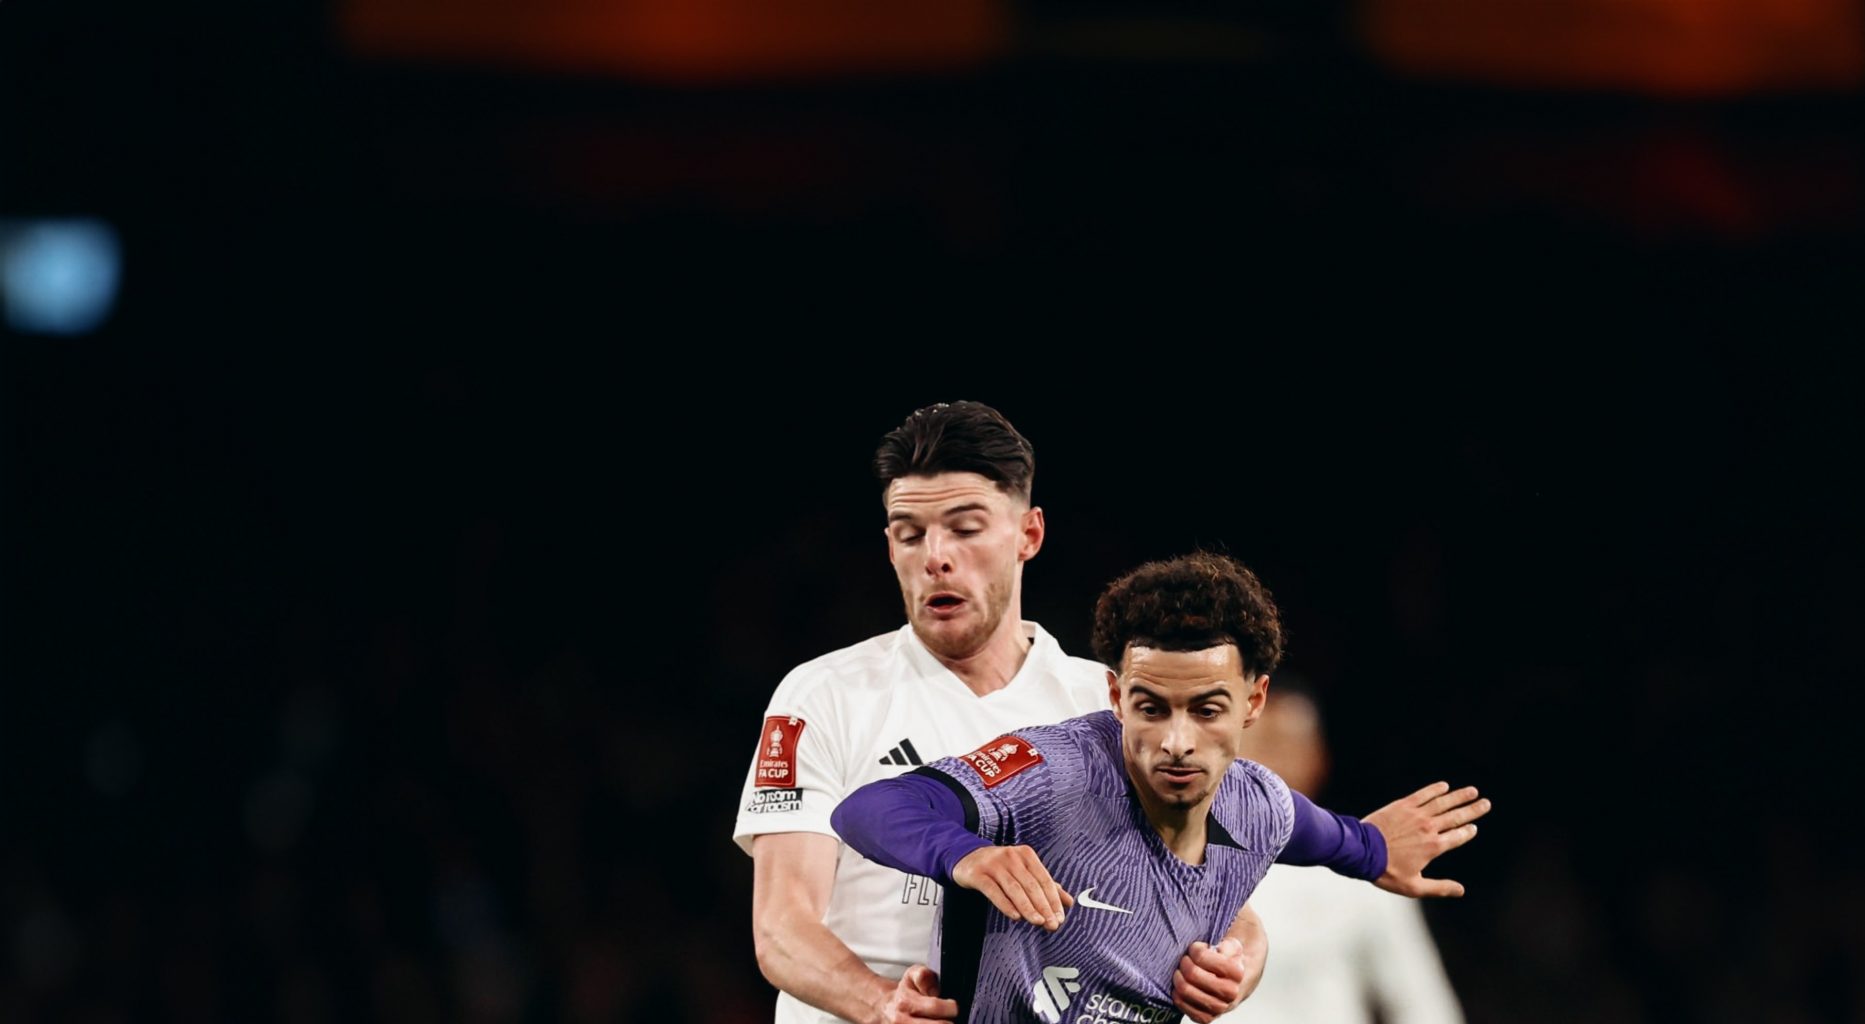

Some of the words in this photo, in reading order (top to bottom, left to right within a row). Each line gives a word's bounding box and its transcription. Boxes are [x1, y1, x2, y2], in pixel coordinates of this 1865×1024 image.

[768, 768, 789, 778] CUP
[975, 759, 995, 777] CUP
[765, 790, 797, 803] room
[764, 800, 802, 812] racism
[1086, 992, 1174, 1023] standar
